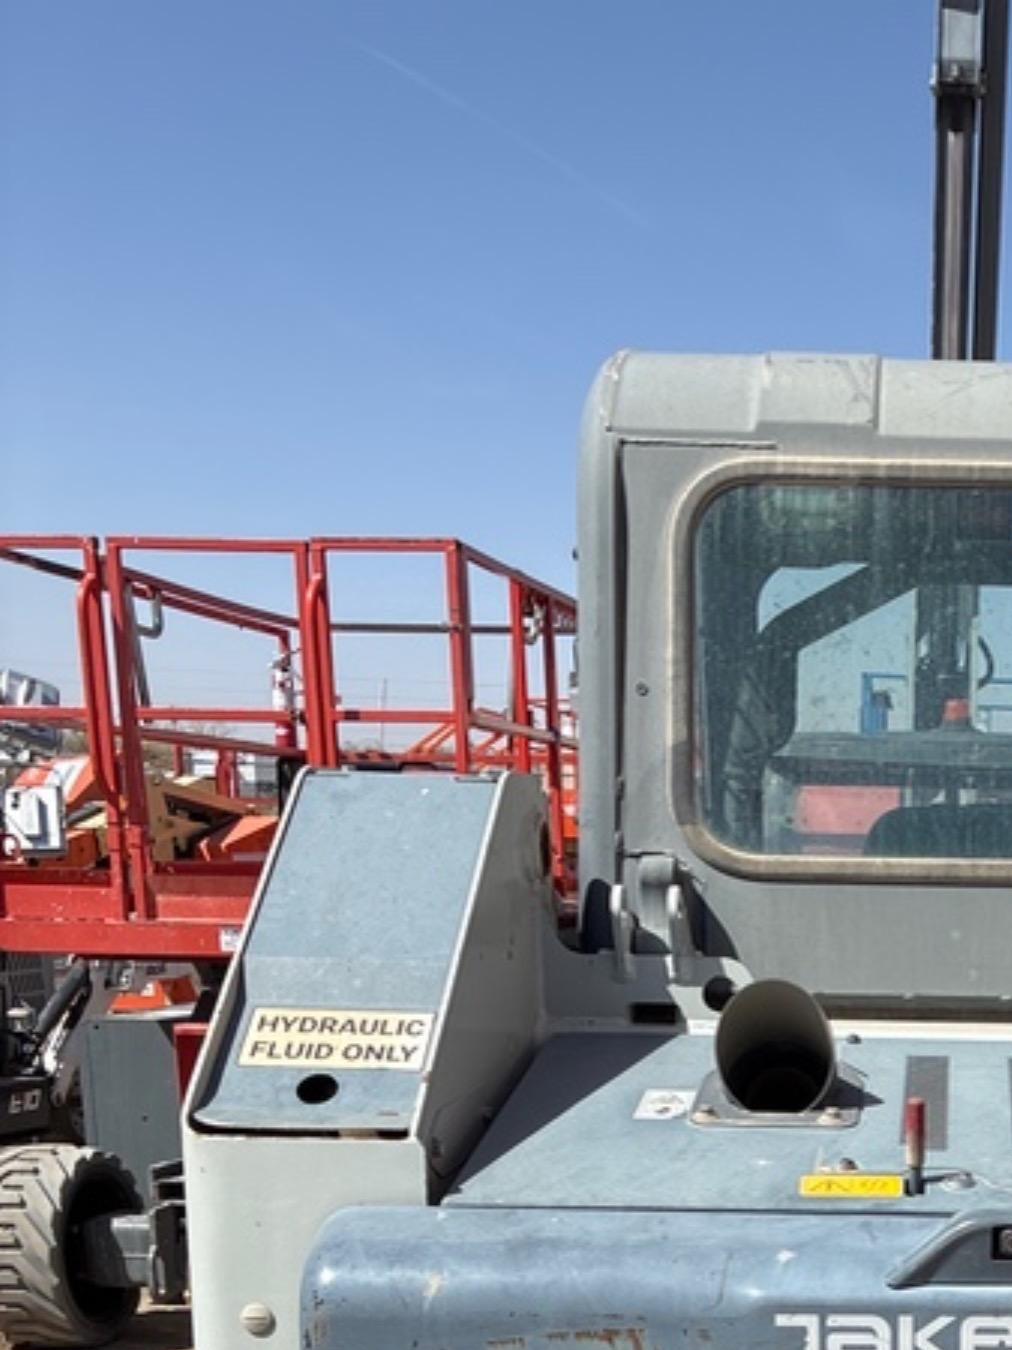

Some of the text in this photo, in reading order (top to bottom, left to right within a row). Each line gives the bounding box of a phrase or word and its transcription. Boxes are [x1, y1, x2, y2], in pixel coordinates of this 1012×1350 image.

[256, 1016, 425, 1036] HYDRAULIC
[249, 1041, 418, 1062] FLUID ONLY
